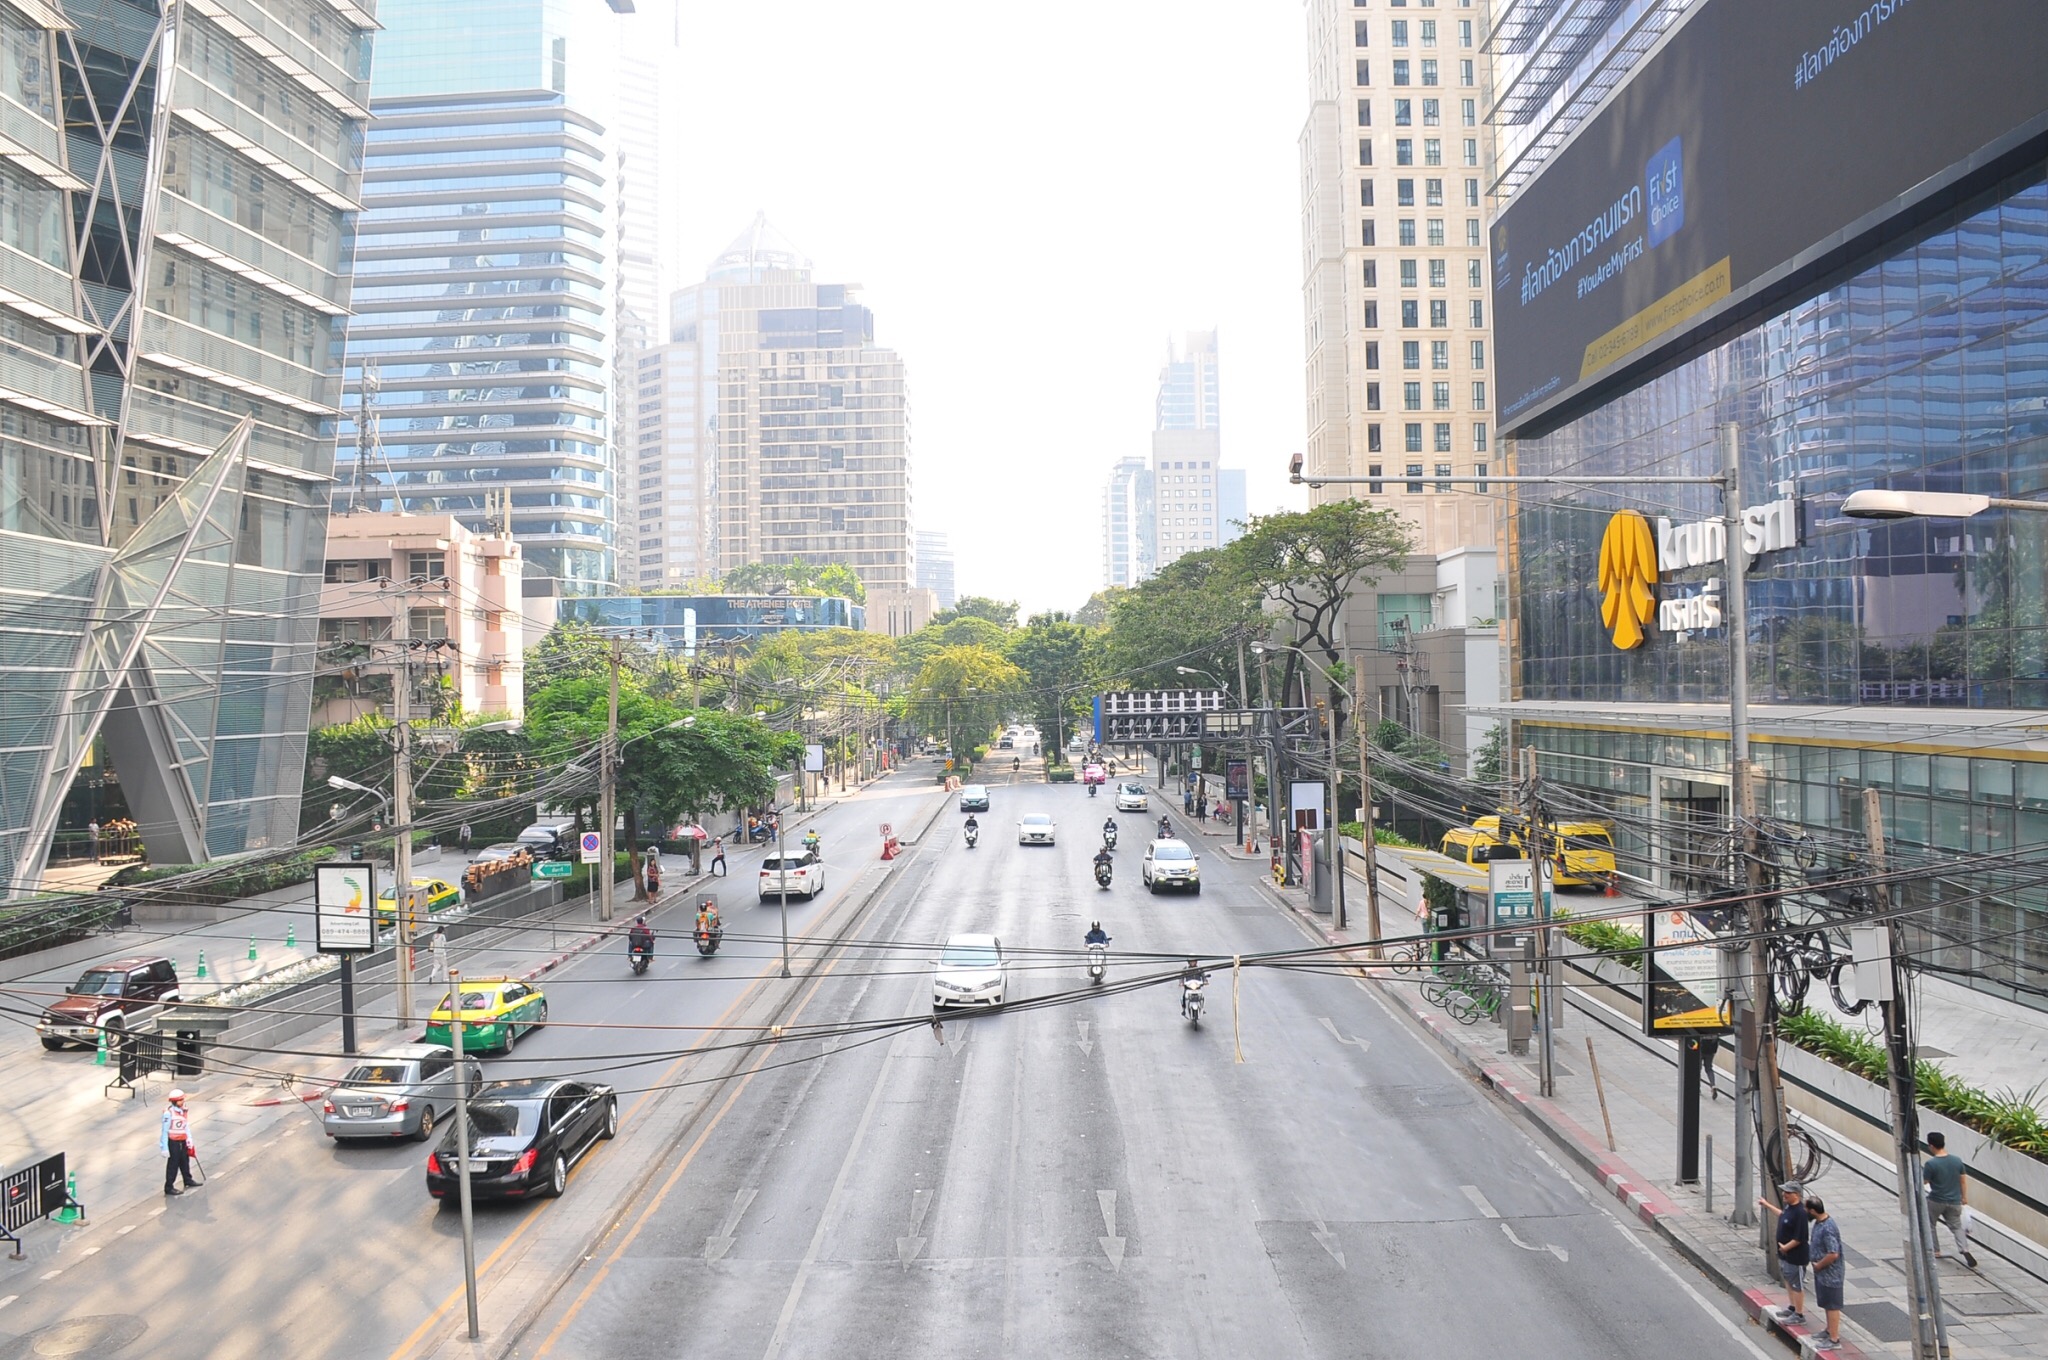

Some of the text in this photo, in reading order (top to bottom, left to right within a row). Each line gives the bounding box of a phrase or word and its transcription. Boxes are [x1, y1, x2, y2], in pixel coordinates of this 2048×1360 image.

[1651, 195, 1679, 226] Choice
[1521, 184, 1641, 306] #โลกต้องการคนแรก
[1577, 235, 1643, 299] #YouAreMyFirst
[727, 599, 814, 609] THE ATHENEE HOTEL
[1659, 577, 1722, 644] กรุงศรี
